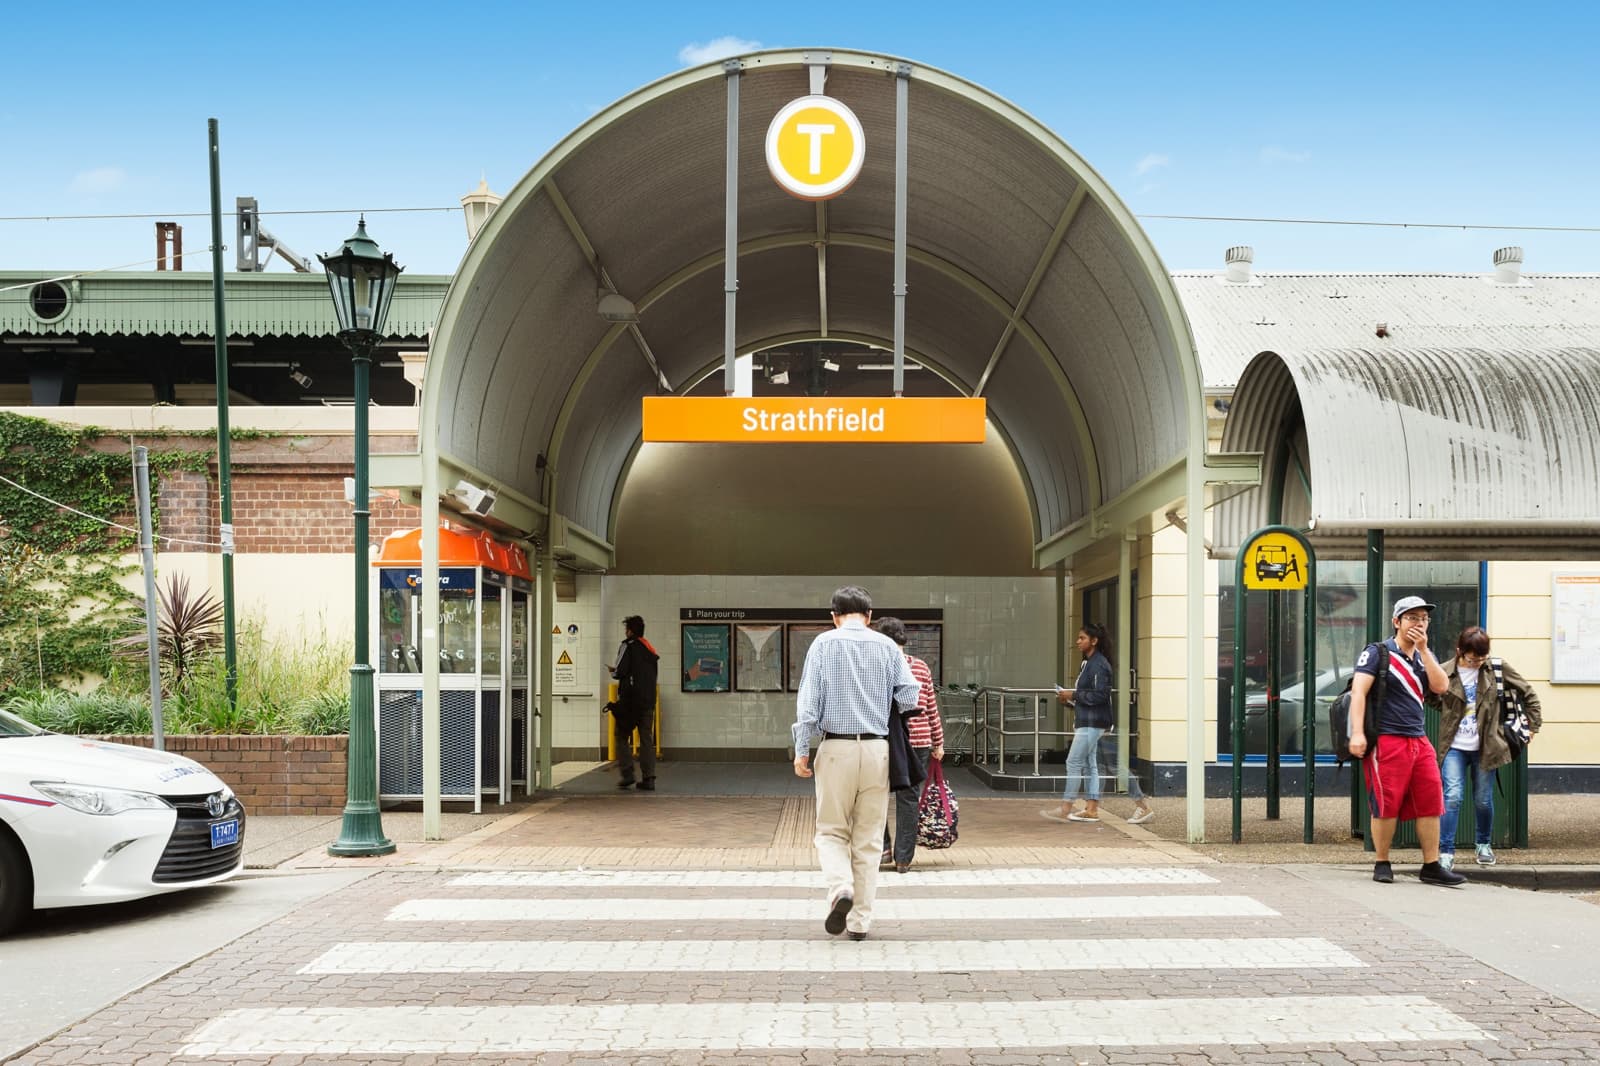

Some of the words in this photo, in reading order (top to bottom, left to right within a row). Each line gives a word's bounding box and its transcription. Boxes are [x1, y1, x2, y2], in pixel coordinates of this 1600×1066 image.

[796, 123, 835, 175] T
[742, 407, 885, 433] Strathfield
[406, 574, 450, 587] Tera
[696, 610, 713, 618] Plan
[713, 611, 731, 619] your
[732, 610, 745, 619] trip
